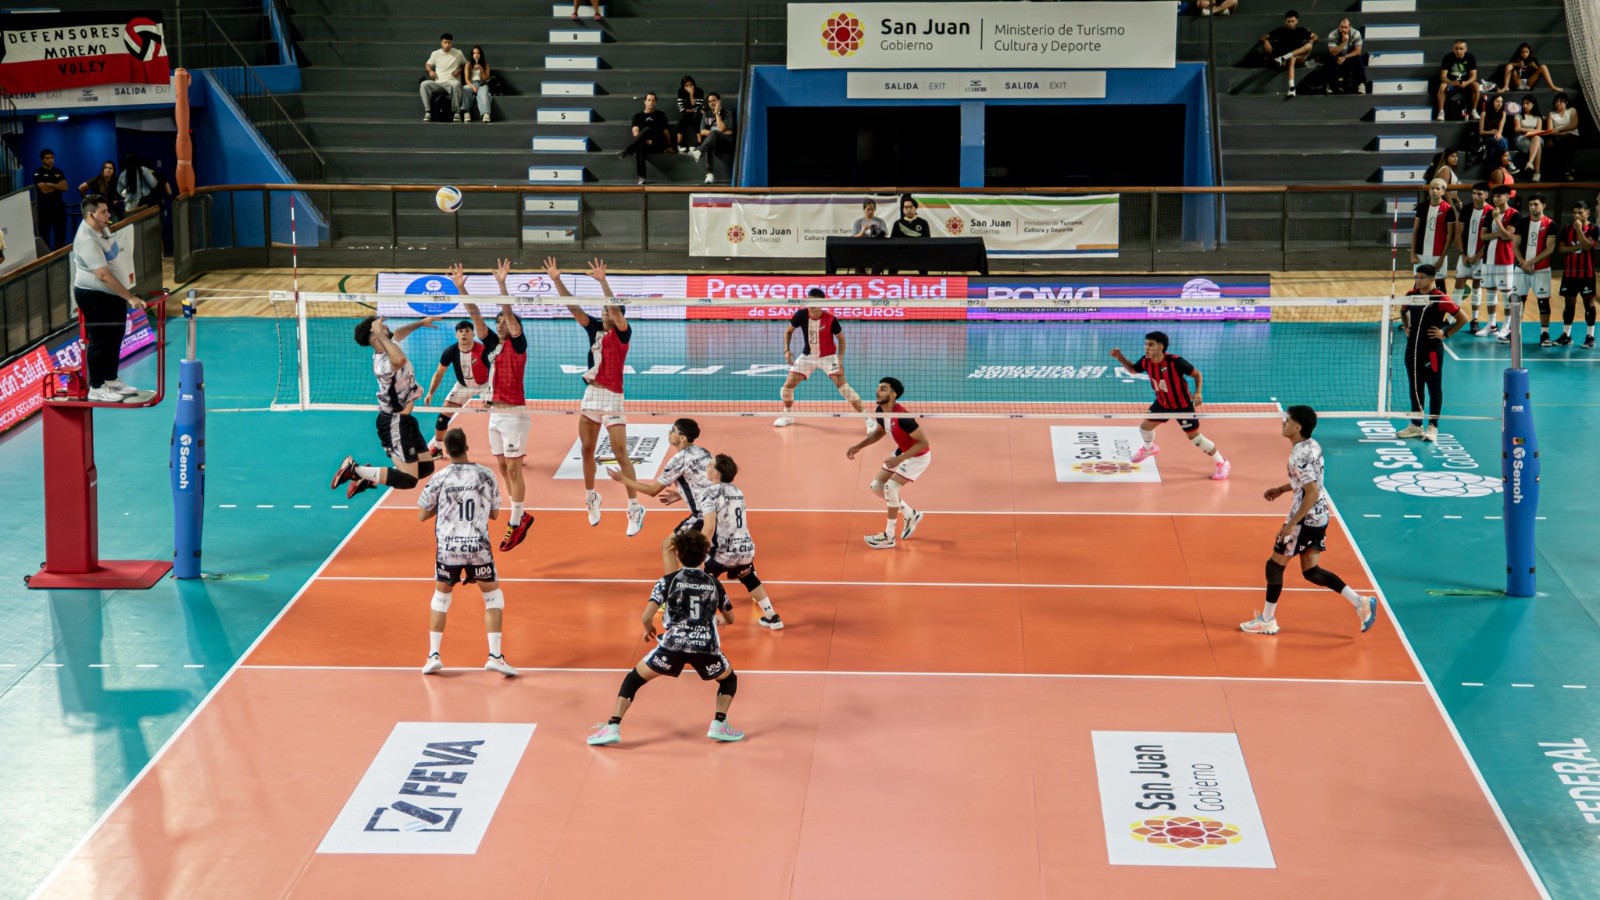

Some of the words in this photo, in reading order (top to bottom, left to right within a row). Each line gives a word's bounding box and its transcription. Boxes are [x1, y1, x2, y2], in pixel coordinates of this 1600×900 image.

[880, 18, 917, 35] San
[923, 18, 970, 35] Juan
[994, 24, 1055, 36] Ministerio
[1058, 24, 1073, 36] de
[1076, 24, 1125, 36] Turismo
[8, 27, 120, 44] DEFENSORES
[44, 44, 107, 59] MORENO
[880, 39, 933, 51] Gobierno
[994, 40, 1038, 51] Cultura
[1040, 42, 1048, 54] y
[1051, 40, 1101, 53] Deporte
[59, 61, 106, 75] VOLEY
[115, 86, 146, 96] SALIDA
[884, 82, 919, 90] SALIDA
[929, 82, 947, 90] EXIT
[1397, 83, 1403, 91] 6
[4, 91, 36, 100] ALIDA
[1400, 111, 1406, 119] 5
[549, 201, 554, 209] 2
[970, 219, 987, 227] San
[989, 219, 1011, 227] Juan
[1051, 226, 1073, 234] Deporte
[751, 227, 768, 235] San
[770, 227, 792, 235] Juan
[868, 278, 946, 299] Salud
[748, 307, 764, 317] de
[834, 307, 905, 317] SEGUROS
[13, 352, 48, 388] Salud
[16, 393, 43, 416] SEGUROS
[1073, 432, 1099, 446] Juan
[1357, 420, 1407, 446] Juan
[1075, 447, 1102, 459] San
[1373, 448, 1423, 469] San
[179, 446, 190, 489] Senoh
[1513, 460, 1523, 504] Senoh
[457, 499, 475, 521] 10
[735, 507, 742, 528] 8
[445, 543, 457, 552] Le
[460, 543, 483, 553] Club
[726, 545, 737, 553] Le
[690, 596, 700, 620] 5
[672, 628, 686, 637] Le
[688, 631, 711, 640] Club
[675, 638, 706, 646] DEPORTES
[1129, 745, 1170, 778] Juan
[398, 740, 486, 798] FEVA
[1188, 763, 1225, 812] Gobierno
[1134, 783, 1177, 811] San
